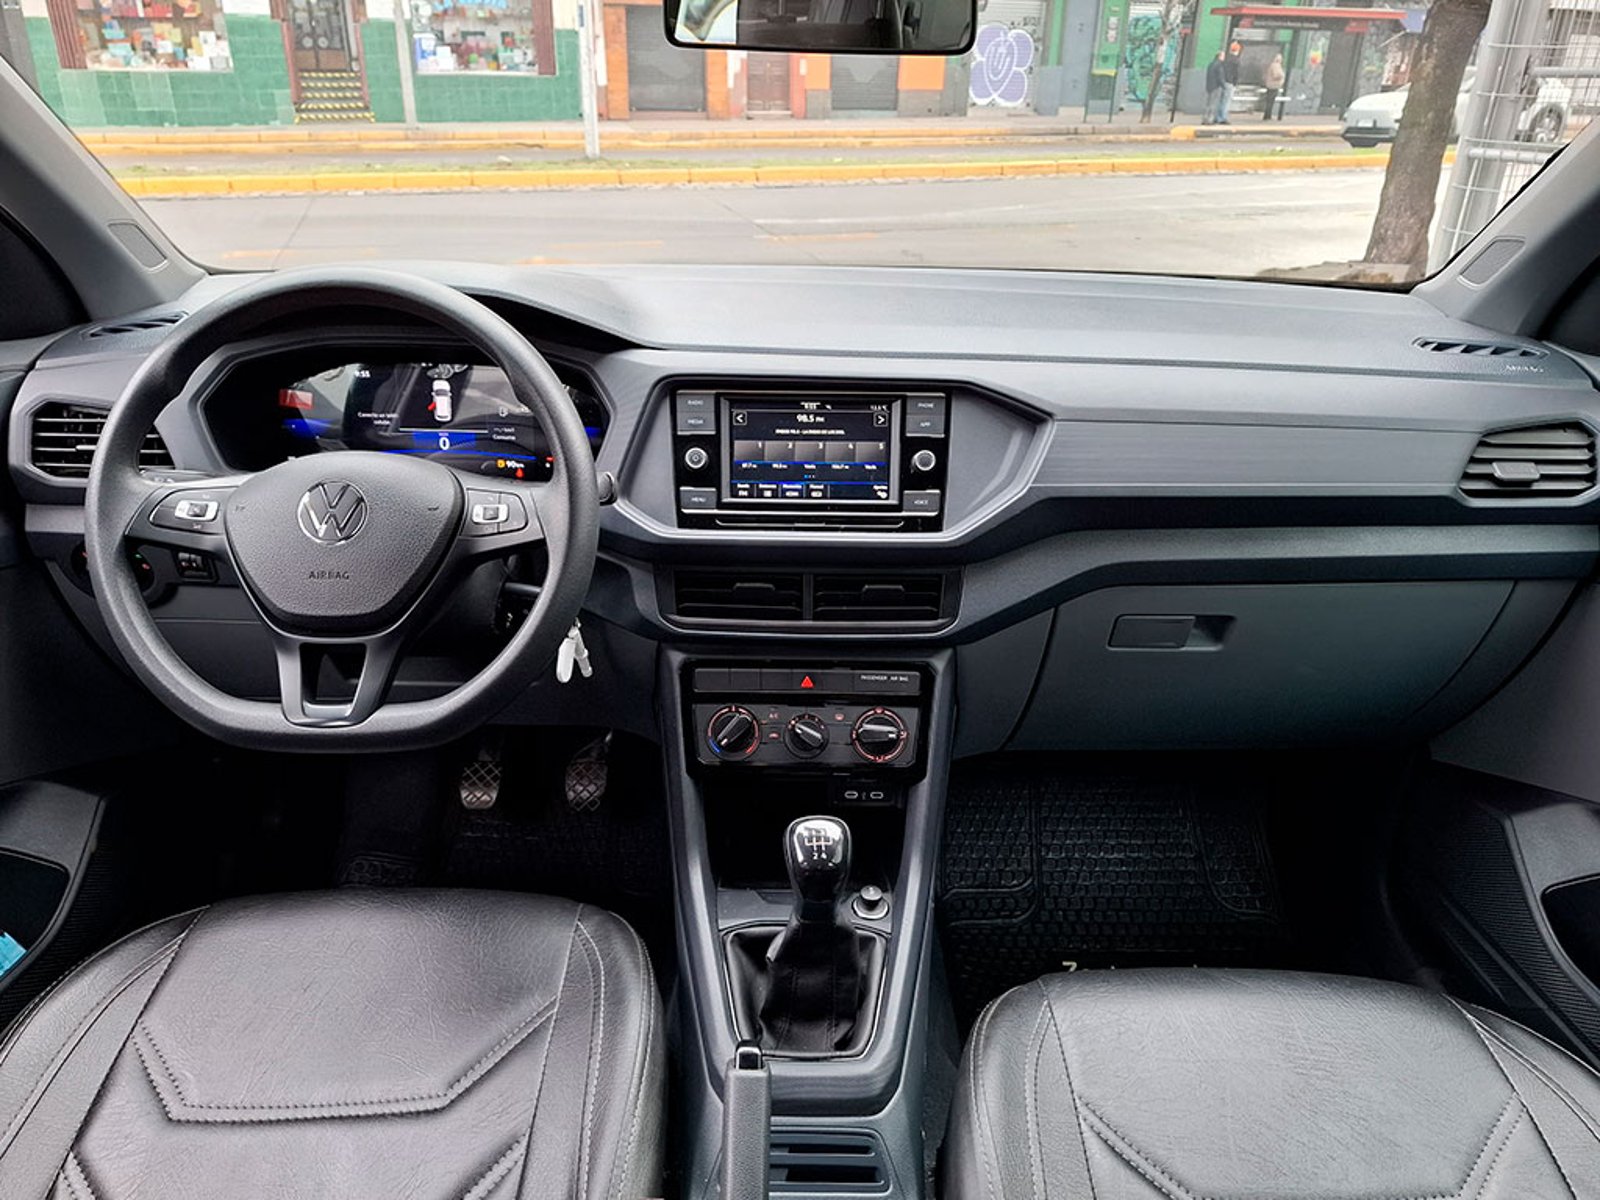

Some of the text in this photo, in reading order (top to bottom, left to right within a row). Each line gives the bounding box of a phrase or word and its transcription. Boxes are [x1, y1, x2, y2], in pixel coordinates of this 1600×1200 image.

[796, 414, 815, 423] 98.5
[439, 437, 450, 451] 0
[879, 442, 885, 450] 5
[308, 570, 351, 580] AIRBAG
[860, 673, 888, 681] PASSENGER
[812, 852, 819, 860] 2
[820, 852, 828, 860] 4
